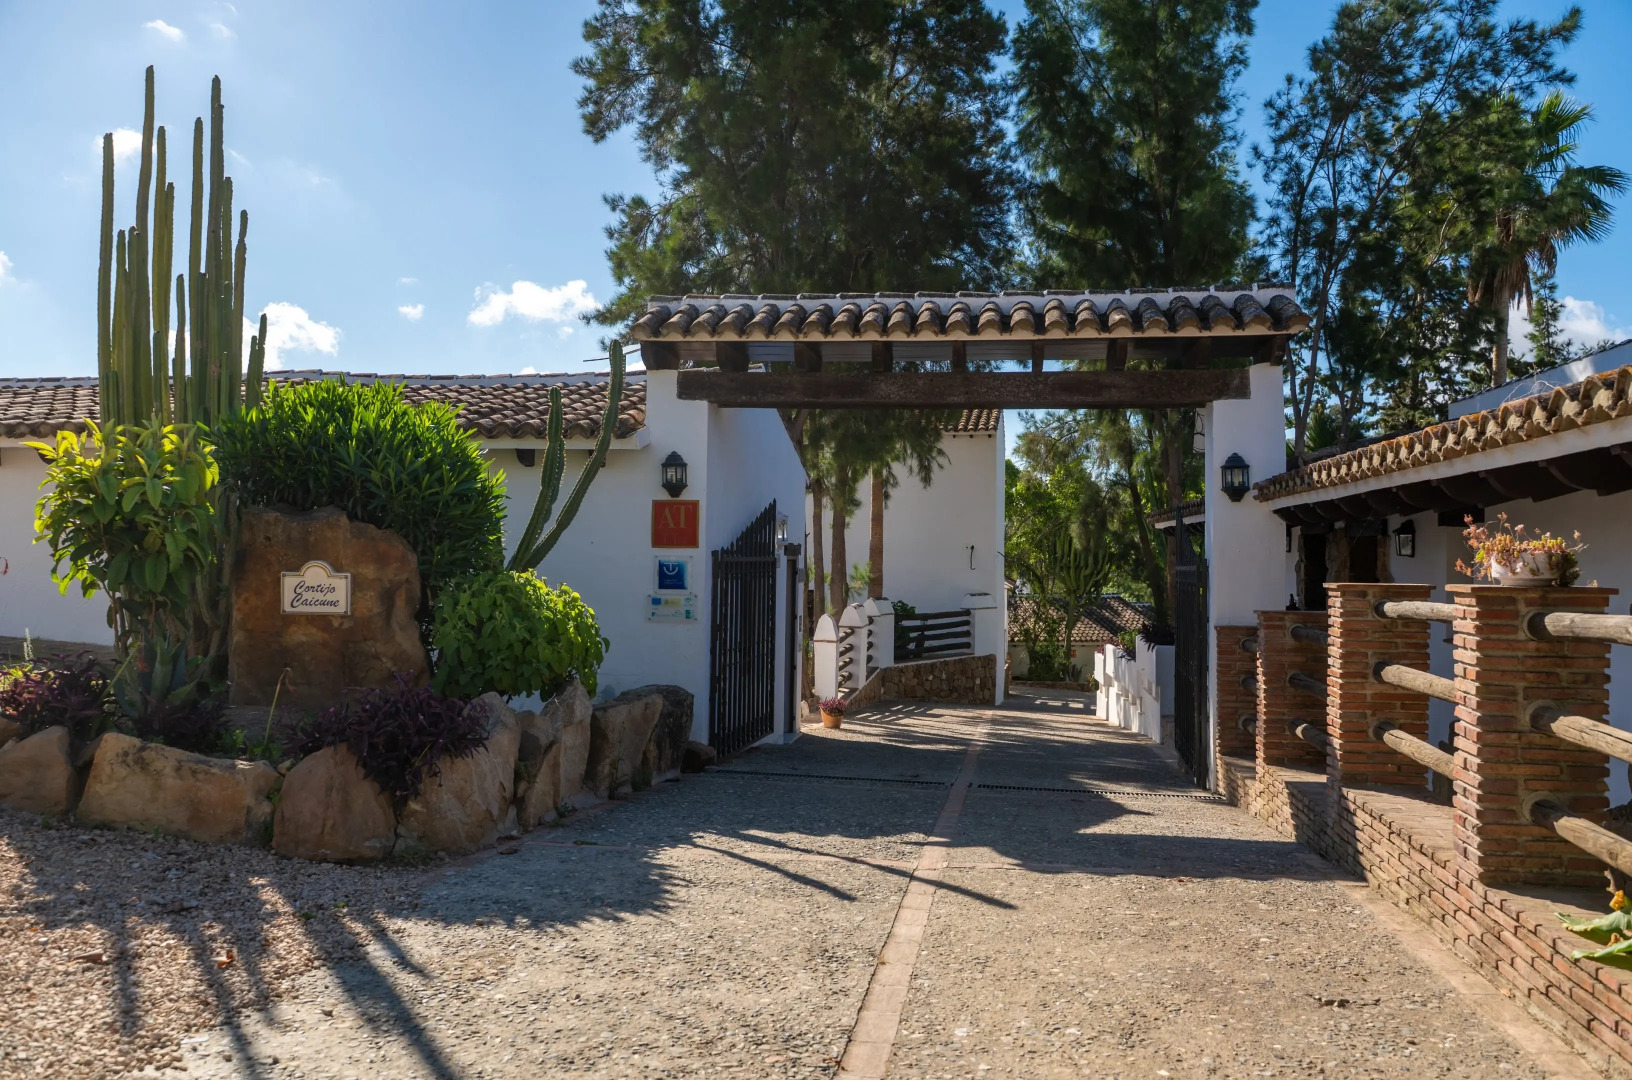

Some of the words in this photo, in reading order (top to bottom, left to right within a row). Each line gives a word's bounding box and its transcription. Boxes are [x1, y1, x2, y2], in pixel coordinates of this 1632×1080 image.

[658, 504, 693, 529] AT
[294, 580, 336, 597] Cortijo
[290, 594, 340, 609] Caicune
